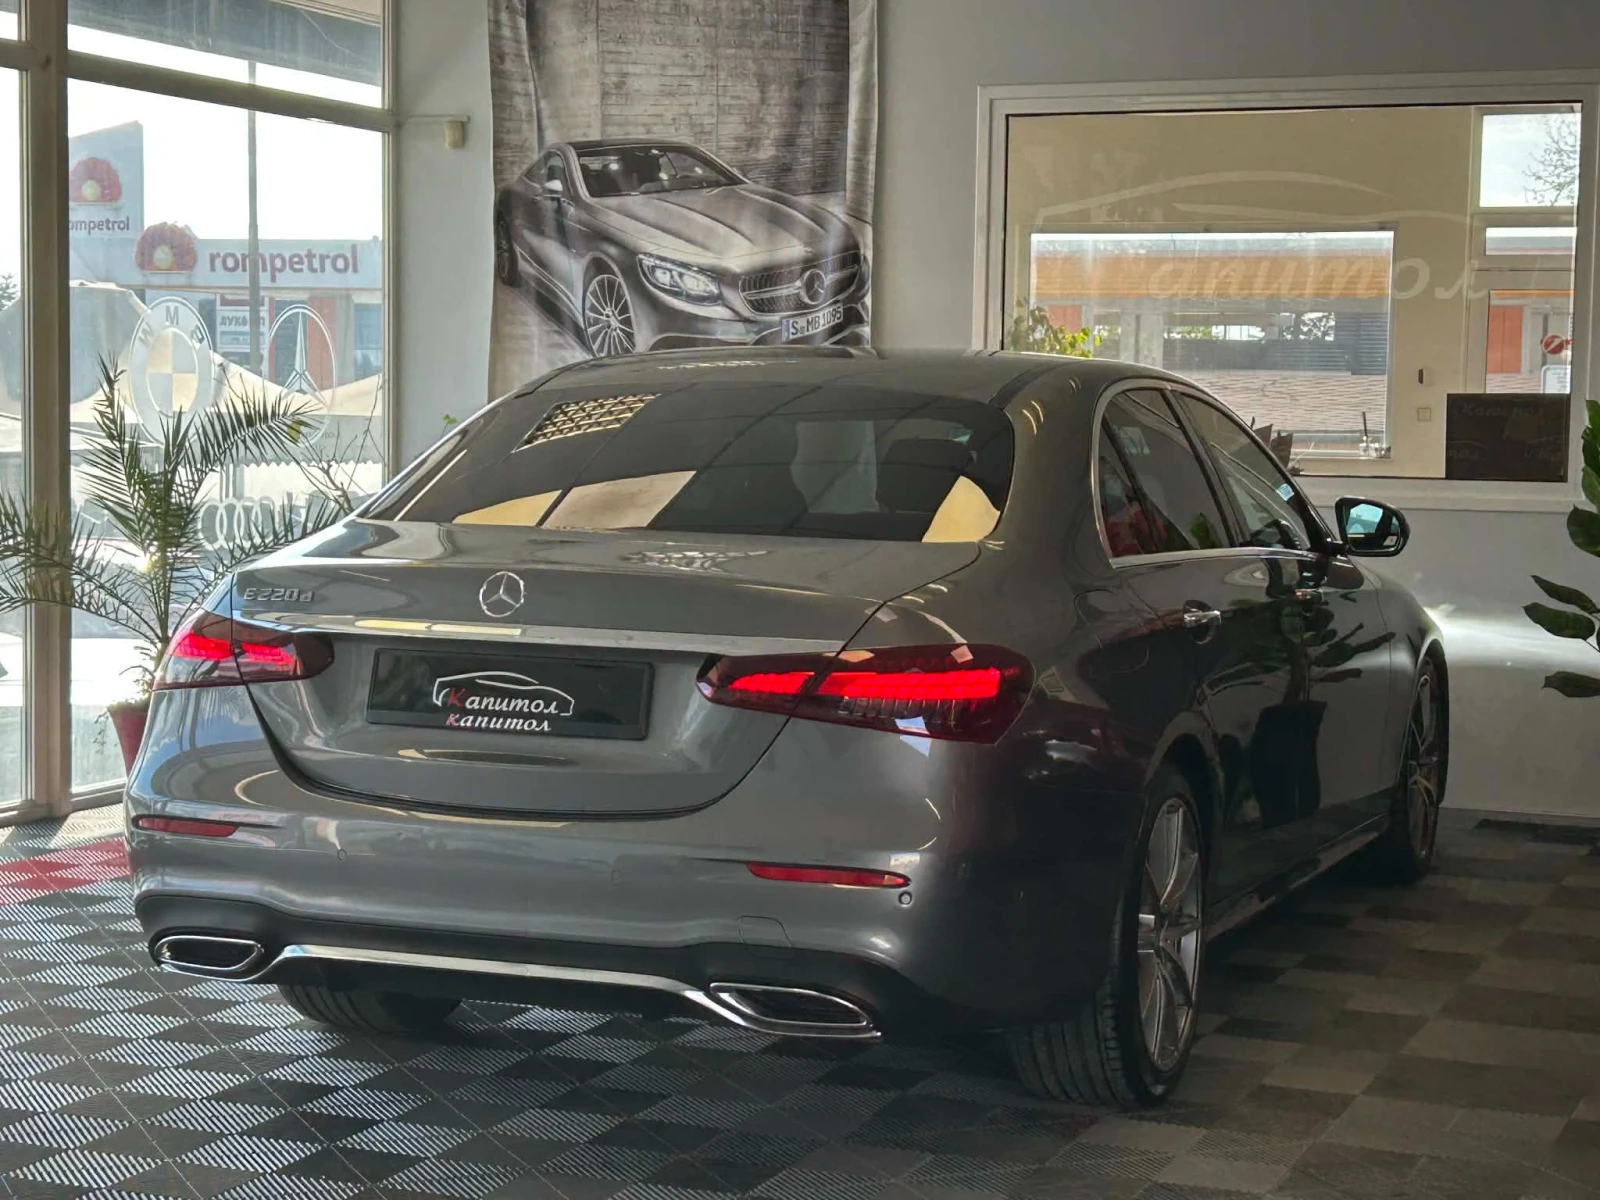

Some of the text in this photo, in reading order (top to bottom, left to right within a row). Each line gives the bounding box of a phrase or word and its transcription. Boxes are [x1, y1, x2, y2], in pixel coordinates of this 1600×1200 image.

[69, 215, 129, 235] ompetrol
[209, 244, 359, 283] rompetrol
[821, 305, 842, 327] 1095
[447, 687, 559, 714] Капитол
